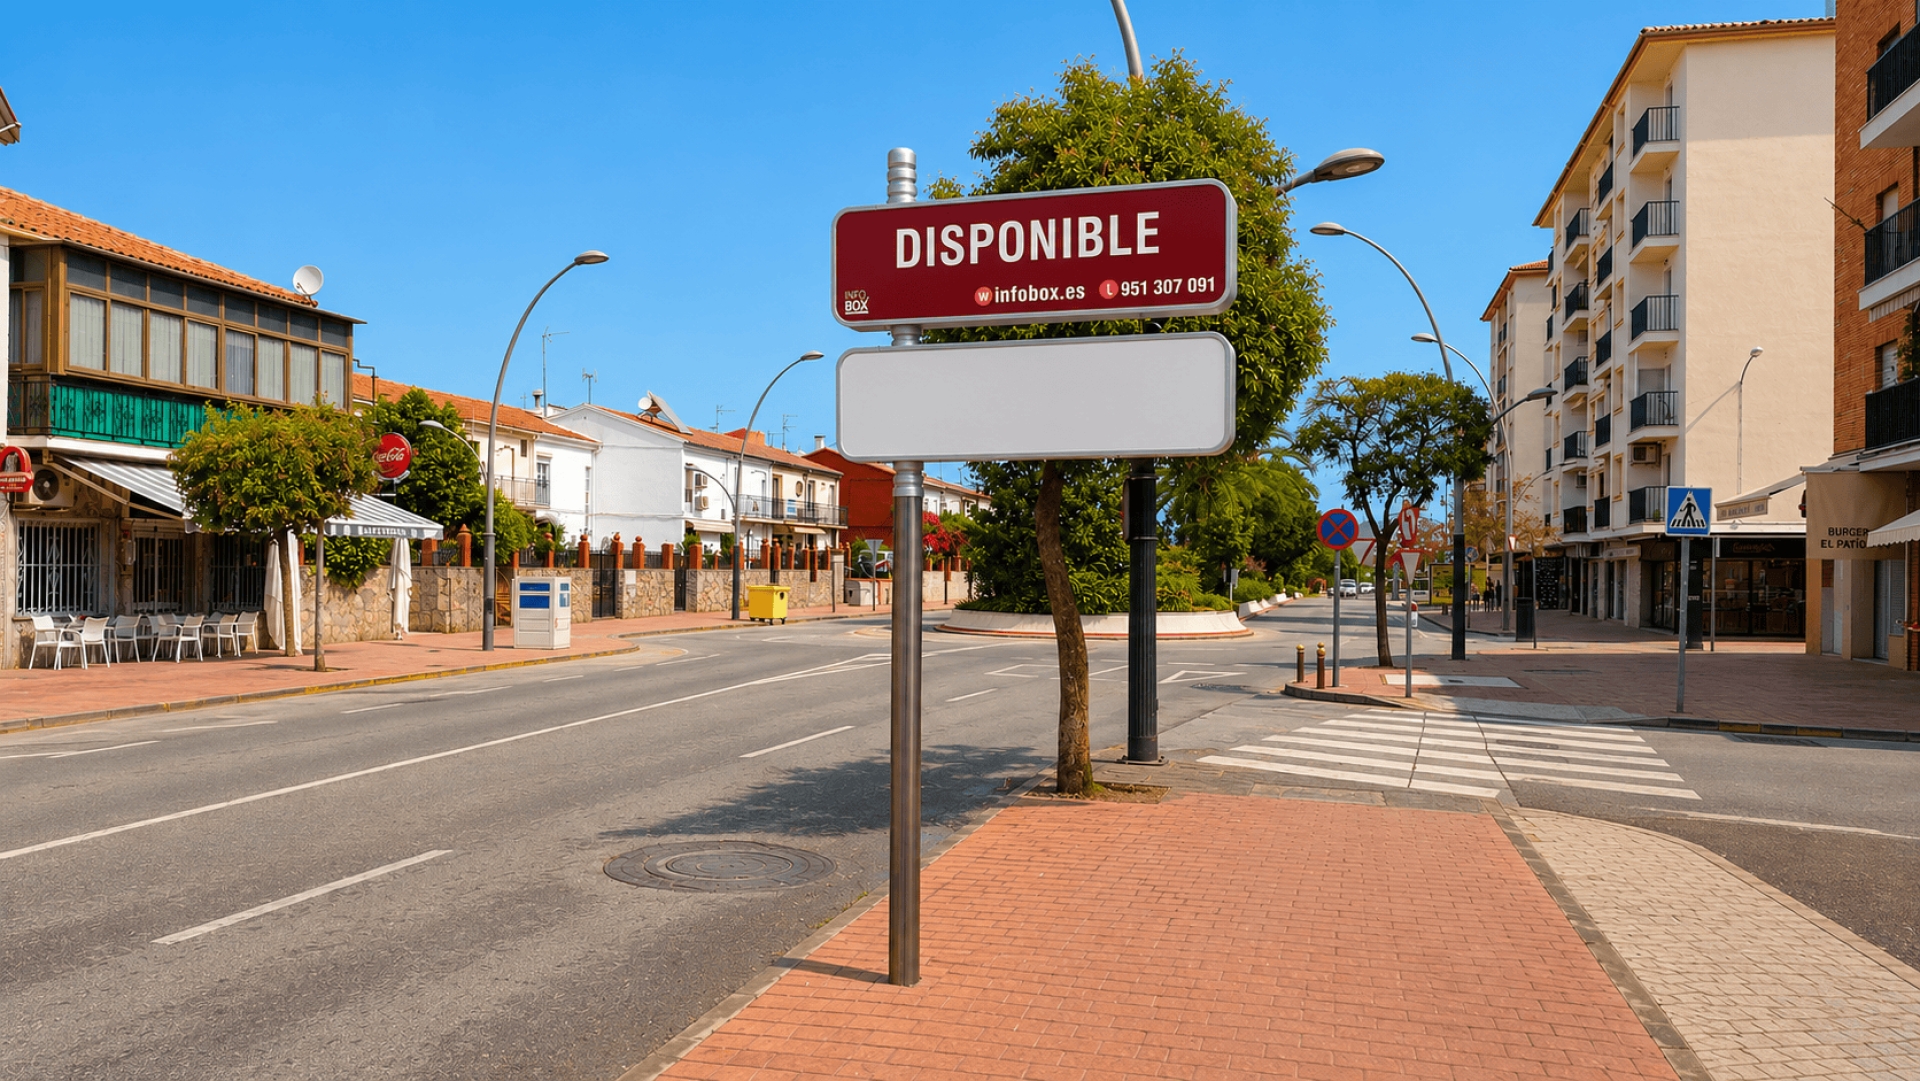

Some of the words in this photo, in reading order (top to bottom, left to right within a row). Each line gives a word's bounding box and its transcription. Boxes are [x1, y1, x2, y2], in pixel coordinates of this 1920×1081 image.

[896, 211, 1160, 269] DISPONIBLE
[994, 284, 1086, 303] infobox.es
[1121, 280, 1147, 297] 951
[1153, 278, 1183, 295] 307
[1187, 276, 1215, 293] 091
[844, 290, 867, 300] INFO
[844, 296, 870, 311] BOX
[1828, 527, 1869, 536] BURGER
[1820, 539, 1834, 549] EL
